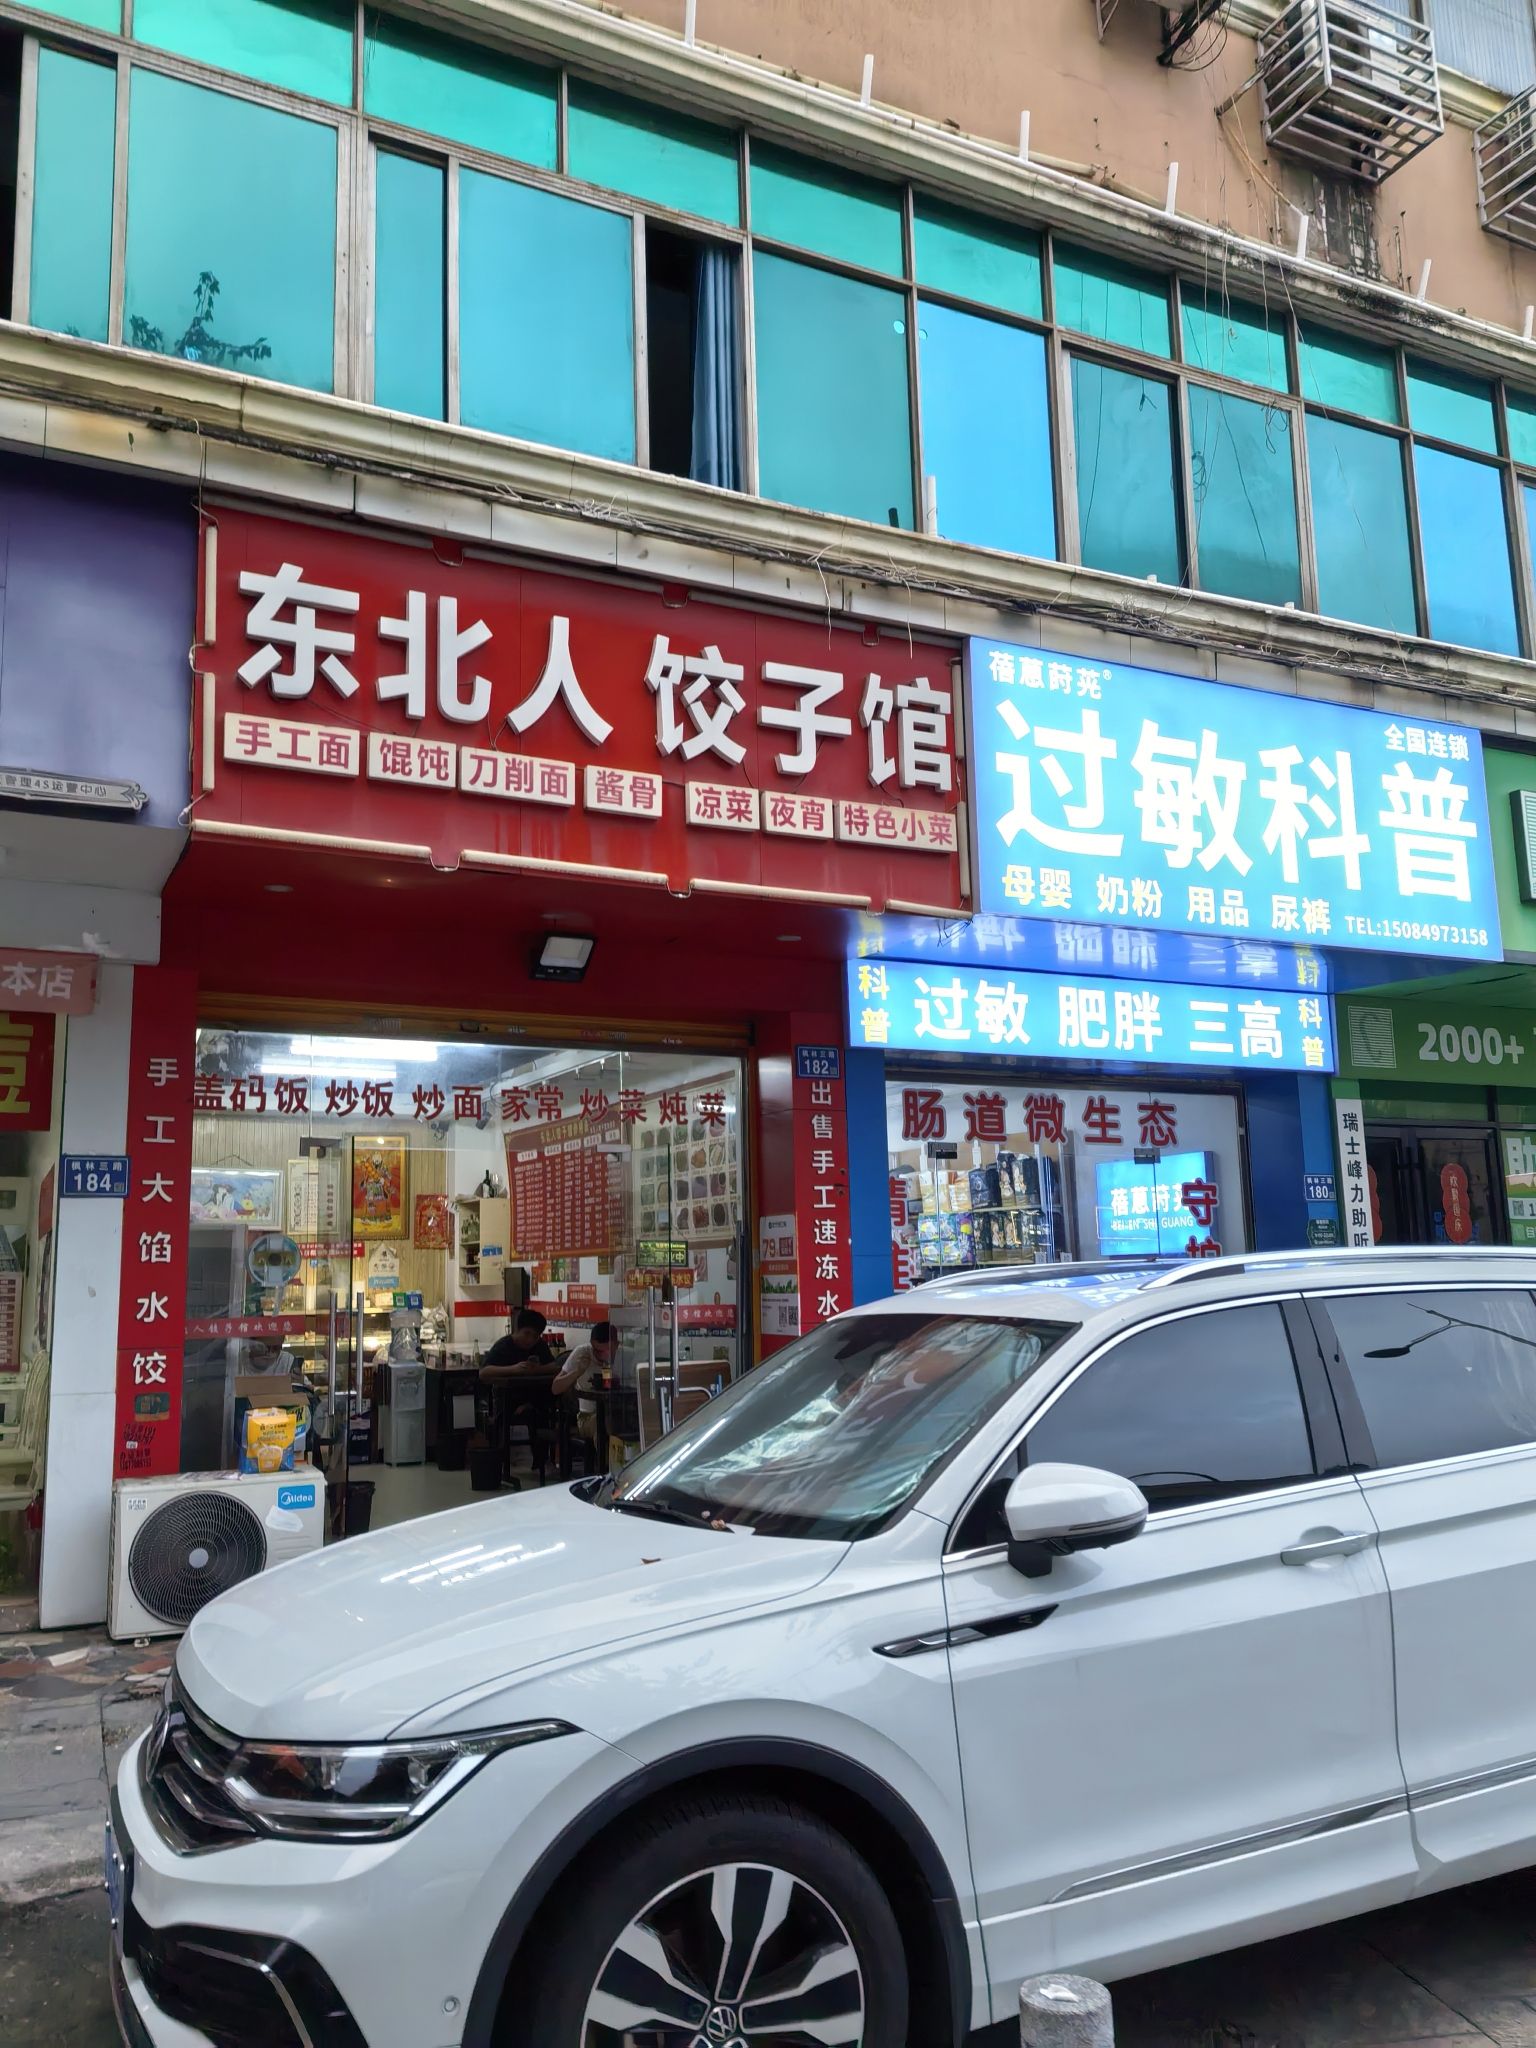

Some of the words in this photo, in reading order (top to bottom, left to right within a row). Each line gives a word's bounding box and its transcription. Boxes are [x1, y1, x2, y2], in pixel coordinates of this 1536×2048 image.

[237, 561, 953, 793] 东北人饺子馆
[1383, 723, 1470, 763] 全国连锁
[235, 718, 352, 768] 手工面
[378, 738, 451, 780] 馄饨
[468, 754, 569, 798] 刀削面
[594, 769, 661, 811] 酱骨
[693, 784, 754, 823] 凉菜
[769, 793, 826, 831] 夜宵
[842, 805, 955, 846] 特色小菜
[995, 699, 1478, 902] 过敏科普
[1002, 864, 1073, 909] 母婴
[1096, 874, 1163, 919] 奶粉
[1186, 885, 1250, 928] 用品
[1270, 893, 1332, 936] 尿裤
[1344, 914, 1489, 947] TEL:15084973158
[1, 961, 75, 999] 本店
[857, 964, 890, 1045] 科普
[912, 976, 1031, 1047] 过敏
[1057, 985, 1164, 1054] 肥胖
[1188, 999, 1284, 1060] 三高
[1297, 998, 1325, 1067] 科普
[1417, 1022, 1525, 1065] 2000+
[804, 1059, 829, 1075] 182
[193, 1074, 310, 1114] 盖码饭
[324, 1079, 395, 1118] 炒饭
[411, 1084, 484, 1121] 炒面
[902, 1089, 1178, 1147] 肠道微生态
[74, 1173, 111, 1192] 184
[810, 1080, 842, 1317] 出售手工速冻水
[1309, 1185, 1329, 1198] 180
[1342, 1112, 1369, 1247] 瑞士峰力助听
[133, 1057, 180, 1385] 手工大馅水饺
[1161, 1214, 1194, 1229] GUANG
[184, 1320, 292, 1335] 人饺子馆欢迎您
[286, 1494, 313, 1505] Midea
